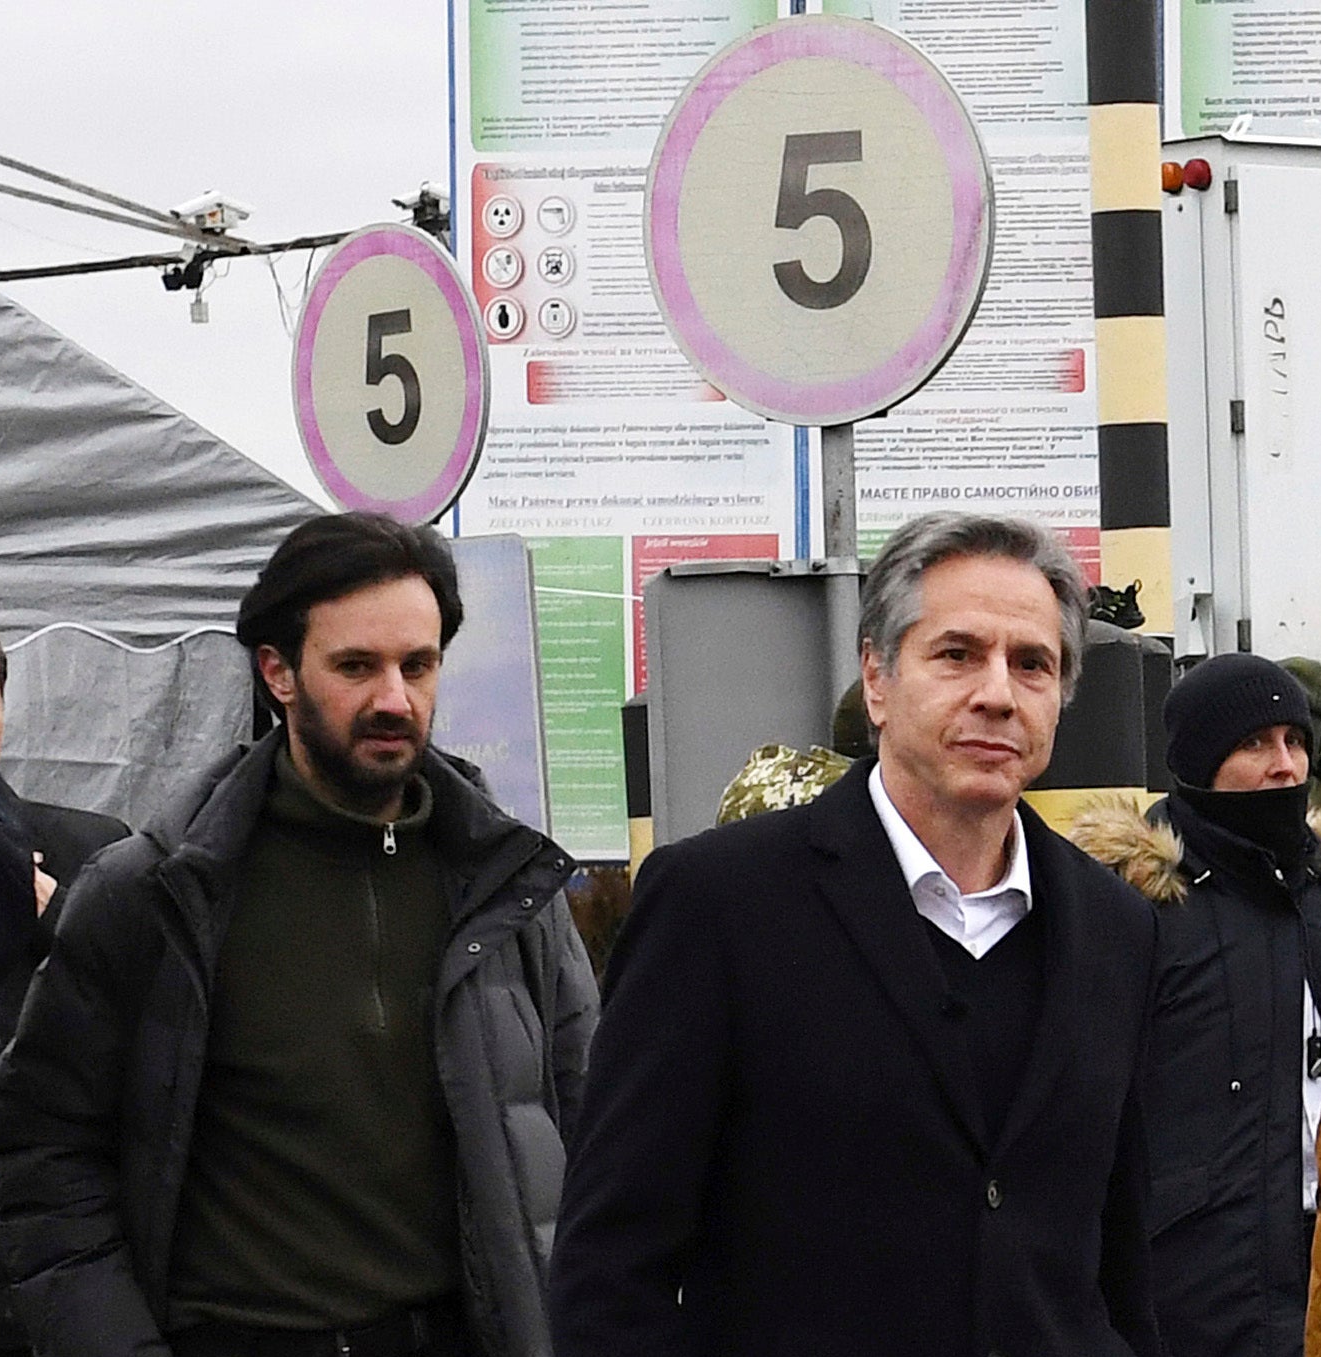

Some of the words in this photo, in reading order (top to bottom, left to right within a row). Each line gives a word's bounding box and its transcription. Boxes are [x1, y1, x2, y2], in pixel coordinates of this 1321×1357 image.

[773, 130, 872, 310] 5
[366, 308, 421, 445] 5
[860, 488, 908, 500] МАЄТЕ
[912, 487, 960, 499] ПРАВО
[964, 483, 1058, 499] САМОСТІЙНО
